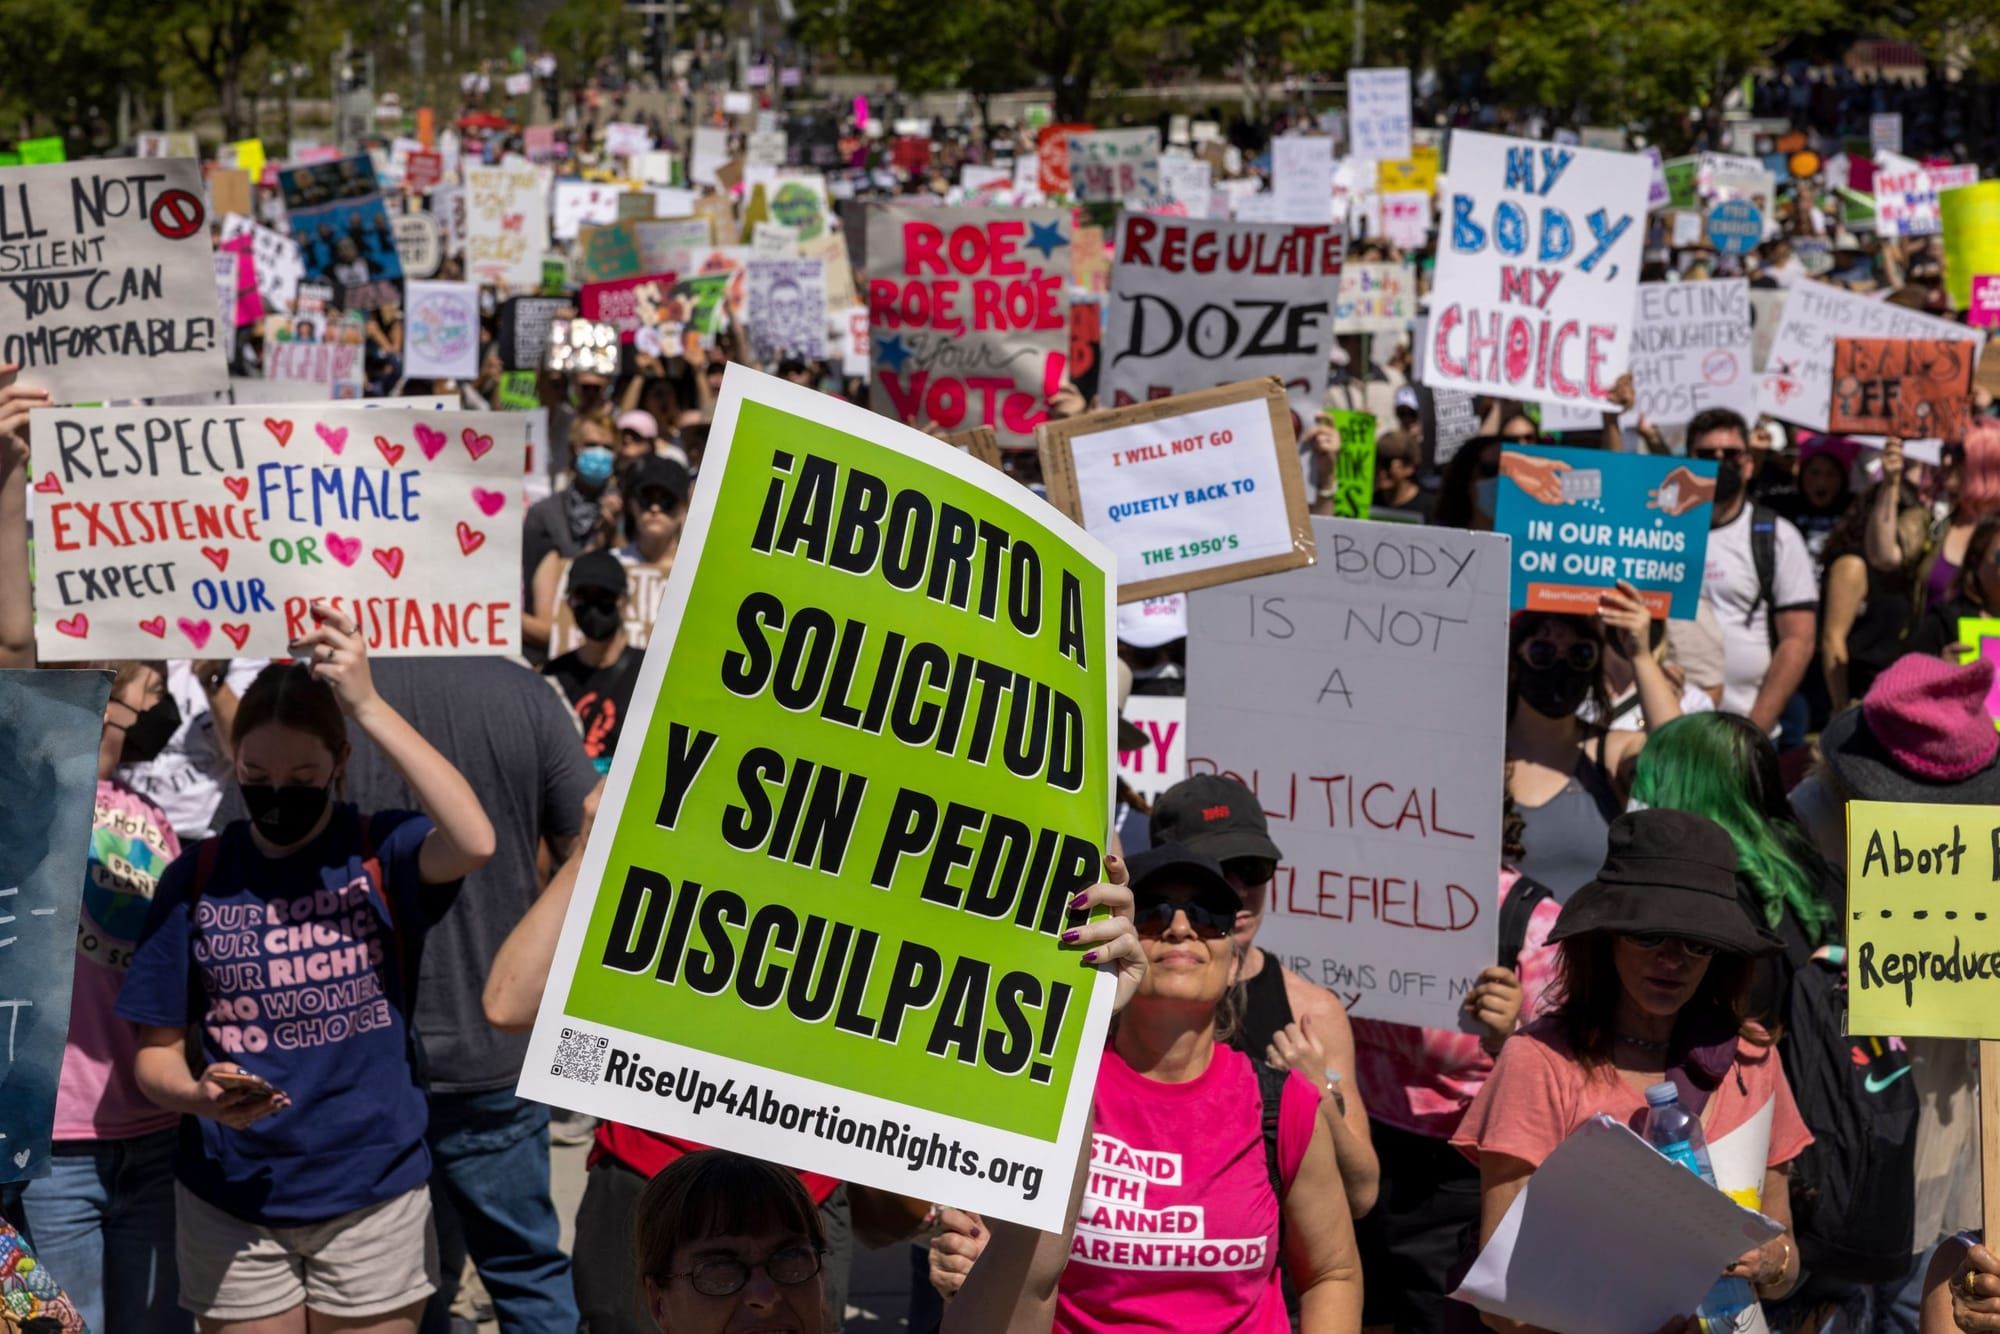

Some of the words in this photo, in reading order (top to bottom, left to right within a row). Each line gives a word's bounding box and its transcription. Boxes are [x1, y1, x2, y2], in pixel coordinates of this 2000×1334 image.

[1505, 146, 1575, 196] MY
[71, 174, 166, 234] NOT
[0, 236, 105, 271] SILENT
[1121, 215, 1343, 276] REGULATE
[1453, 193, 1633, 282] BODY,
[9, 277, 70, 320] YOU
[86, 264, 163, 311] CAN
[869, 279, 968, 338] ROE,
[973, 276, 1065, 331] ROE
[1500, 265, 1563, 309] MY
[1801, 292, 1852, 326] THIS
[1112, 291, 1329, 368] DOZE
[1434, 303, 1617, 399] CHOICE
[55, 417, 246, 483] RESPECT
[1112, 453, 1122, 467] I
[1125, 443, 1167, 465] WILL
[1171, 435, 1204, 455] NOT
[1209, 430, 1233, 447] GO
[257, 461, 421, 527] FEMALE
[1108, 494, 1180, 523] QUIETLY
[1185, 483, 1229, 503] BACK
[1231, 478, 1255, 496] TO
[51, 499, 261, 551] EXISTENCE
[269, 536, 323, 565] OR
[1141, 548, 1174, 566] THE
[1178, 534, 1240, 560] 1950'S
[1528, 520, 1553, 541] IN
[1559, 521, 1612, 547] OUR
[1618, 526, 1685, 553] HANDS
[751, 449, 1043, 638] ¡ABORTO
[1058, 568, 1089, 672] A
[1333, 534, 1476, 588] BODY
[1519, 551, 1557, 573] ON
[1563, 553, 1616, 577] OUR
[1622, 557, 1685, 583] TERMS
[56, 561, 176, 606] EXPECT
[192, 577, 276, 615] OUR
[1250, 594, 1295, 639] IS
[1345, 604, 1468, 652] NOT
[720, 592, 1086, 794] SOLICITUD
[1318, 668, 1353, 708] A
[655, 718, 719, 831] Y
[721, 746, 869, 877] SIN
[870, 786, 1101, 939] PEDIR
[1862, 825, 1967, 878] Abort
[195, 901, 264, 931] OUR
[195, 930, 260, 962] OUR
[204, 963, 265, 994] OUR
[262, 972, 385, 1020] WOMEN
[601, 864, 1073, 1086] DISCULPAS!
[1323, 958, 1377, 989] BANS
[1389, 968, 1437, 996] OFF
[206, 1025, 268, 1054] PRO
[274, 1000, 392, 1049] CHOICE
[604, 1048, 1044, 1201] RiseUp4AbortionRights.org
[1088, 1172, 1140, 1202] ITH
